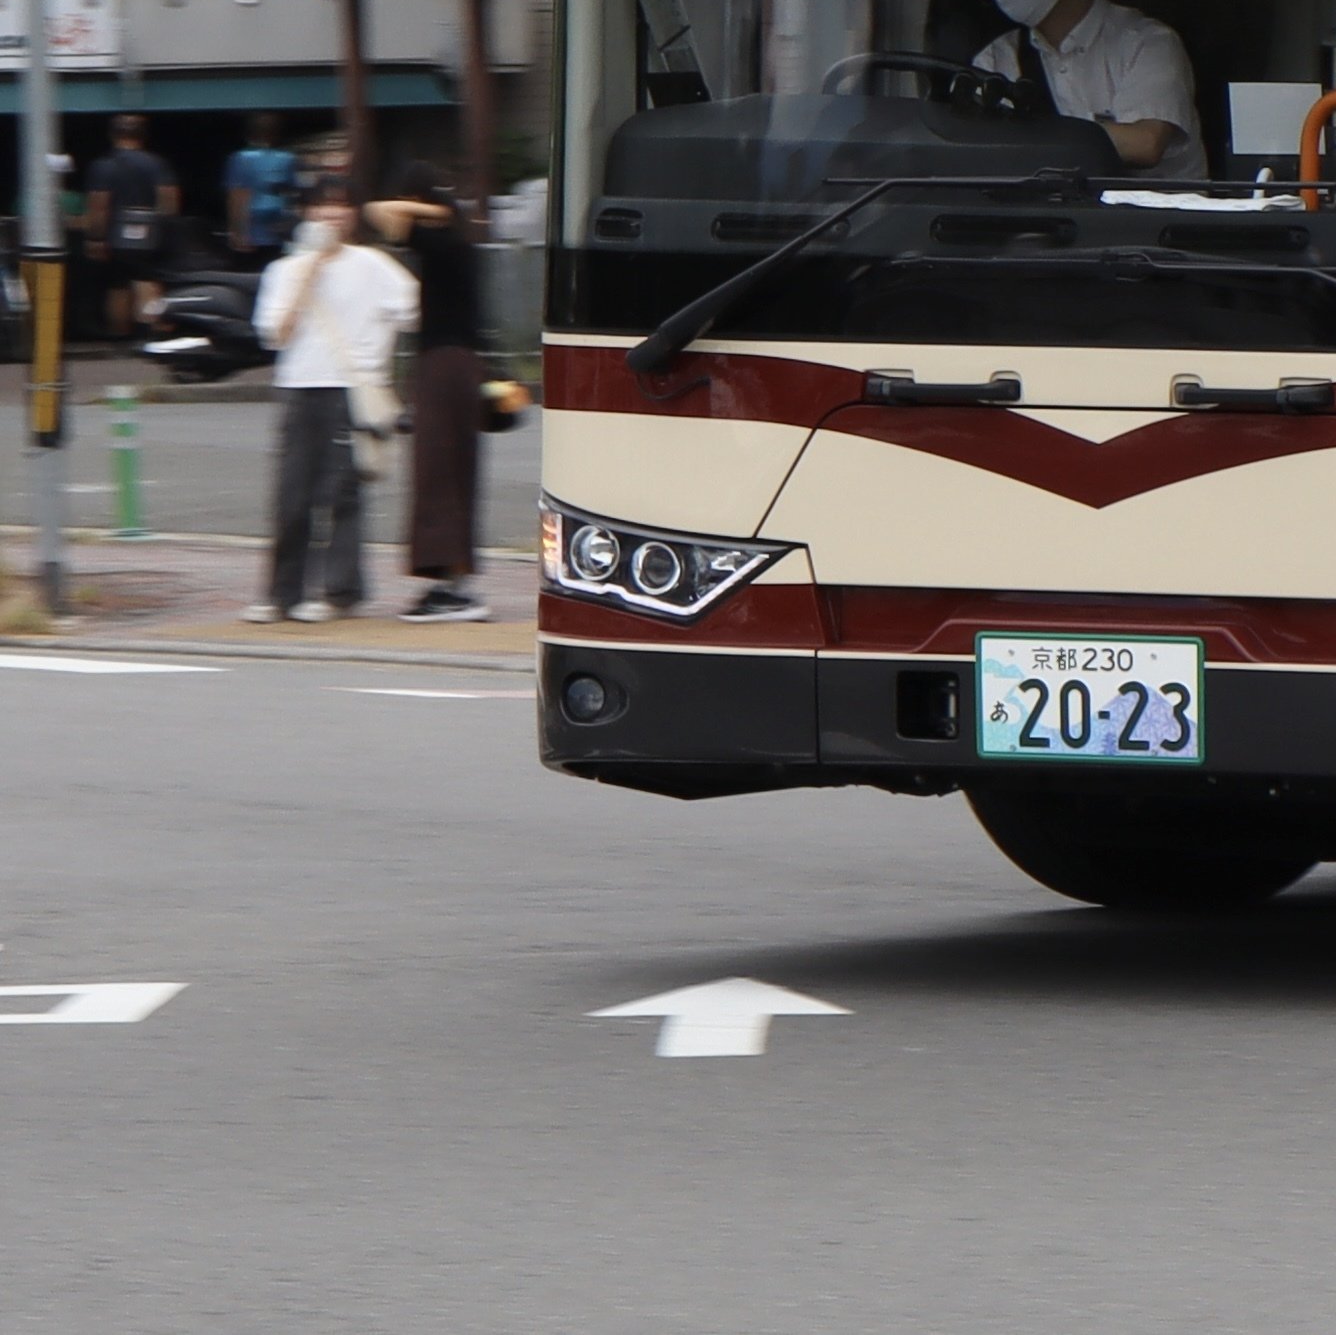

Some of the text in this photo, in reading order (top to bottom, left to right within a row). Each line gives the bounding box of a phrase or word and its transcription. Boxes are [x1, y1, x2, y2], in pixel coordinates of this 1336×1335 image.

[1032, 647, 1134, 672] 京都230
[990, 678, 1191, 752] あ 20-23
